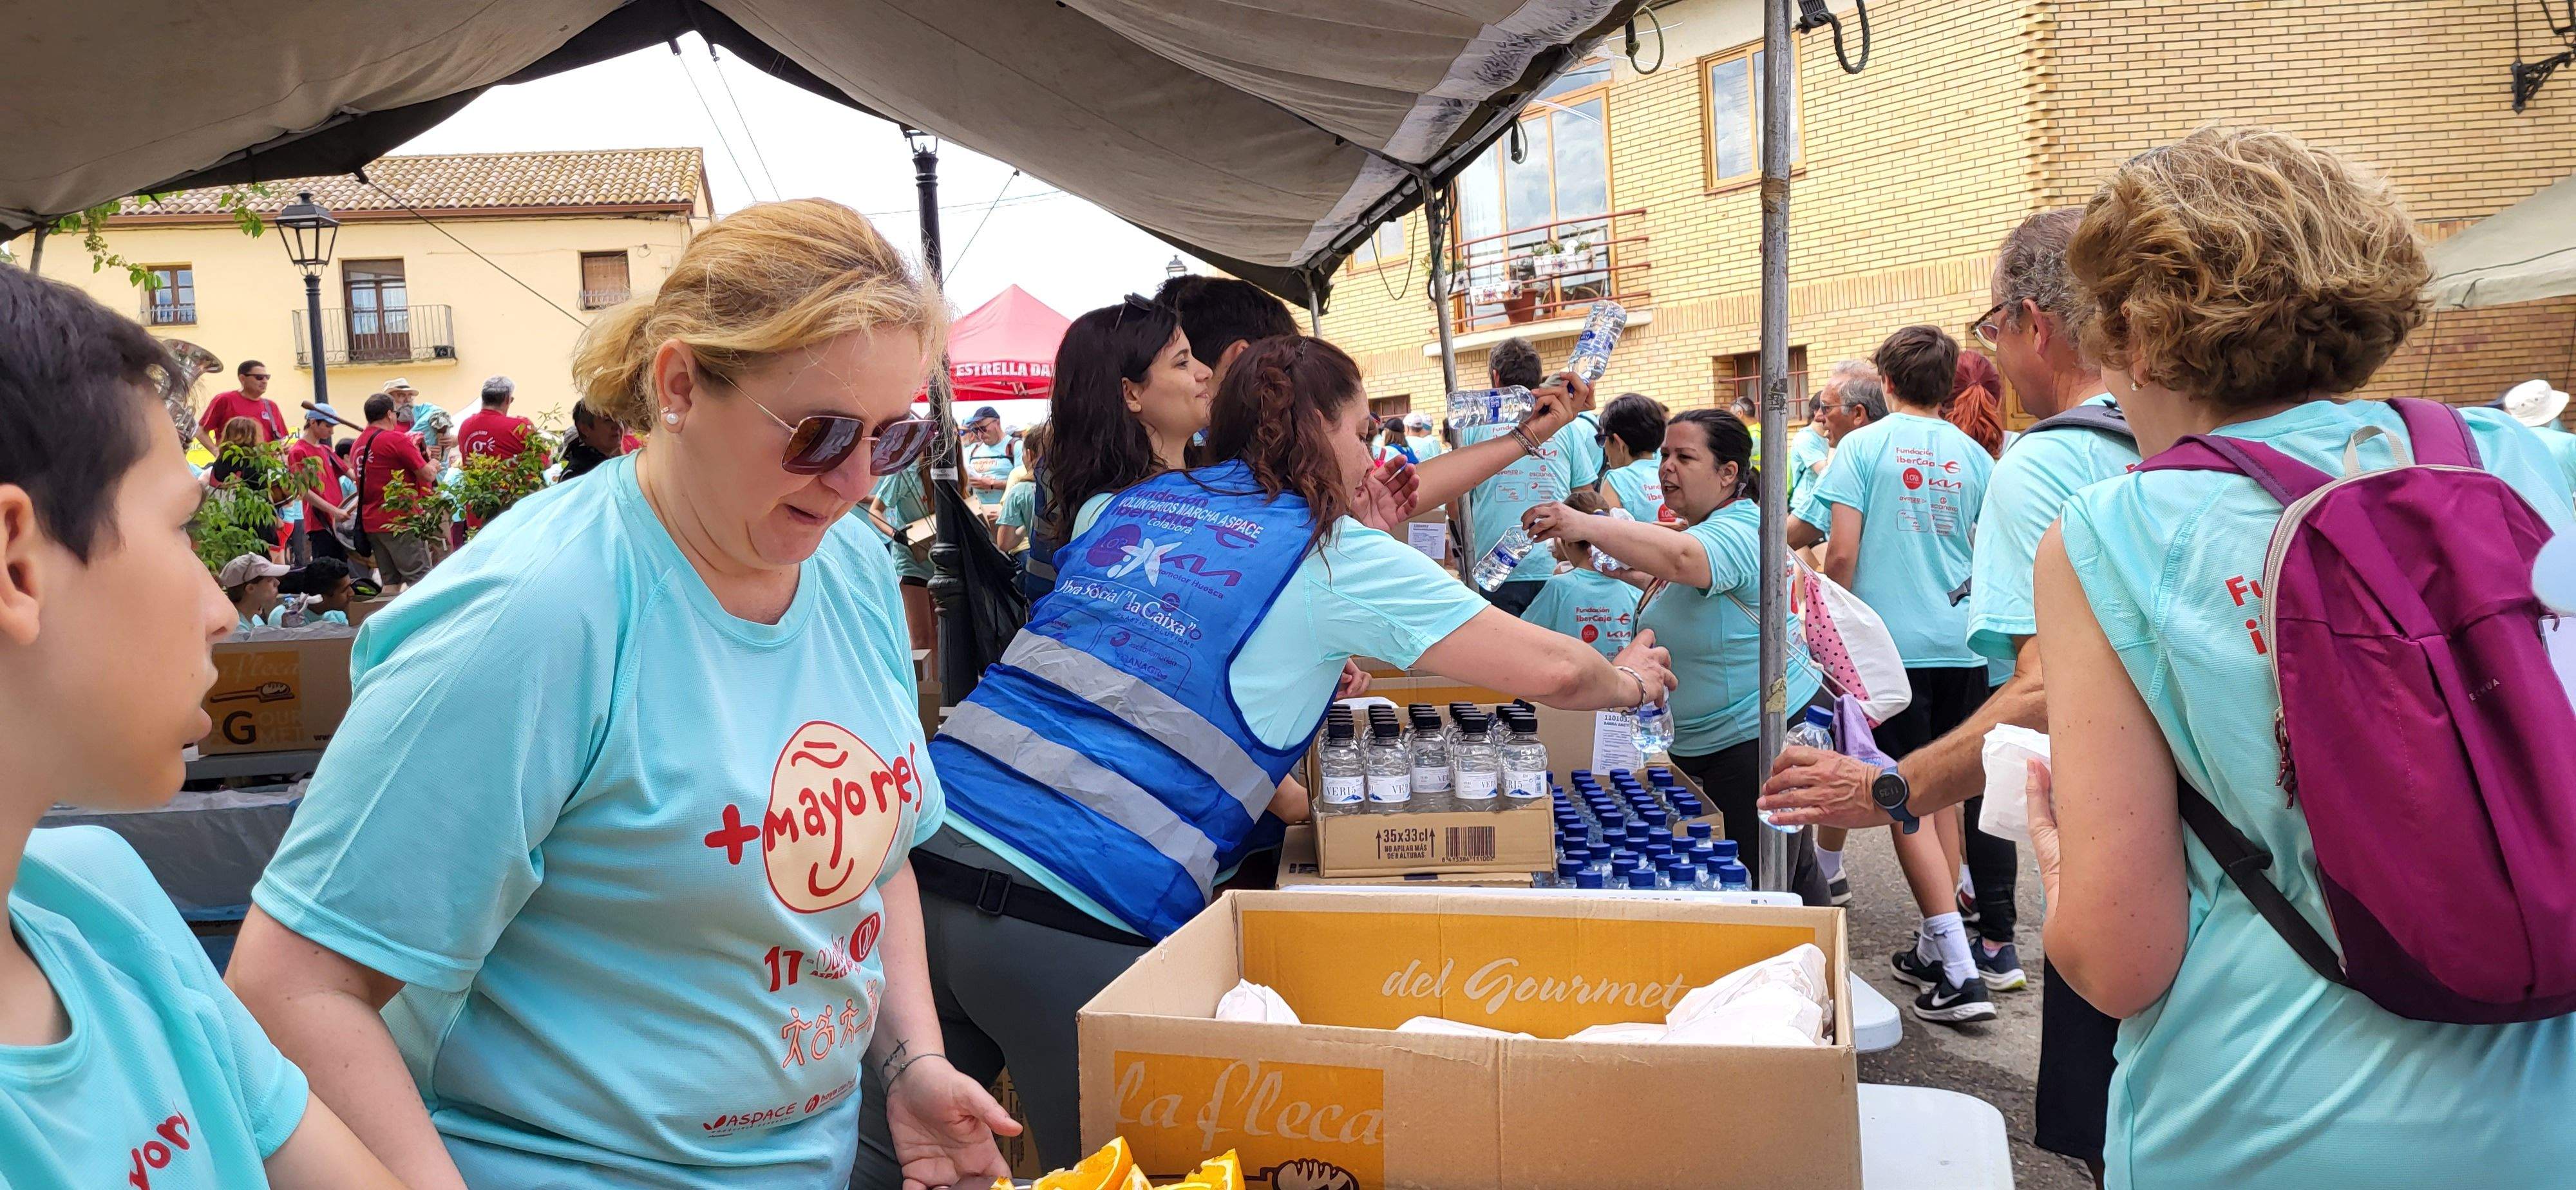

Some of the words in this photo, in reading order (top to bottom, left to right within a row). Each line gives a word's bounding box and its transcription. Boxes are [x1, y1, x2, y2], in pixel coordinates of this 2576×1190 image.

[955, 363, 1028, 377] ESTRELLA
[1030, 363, 1055, 377] DA
[1118, 496, 1179, 514] VOLUNTARIOS
[1177, 502, 1218, 523] MARCHA
[1217, 515, 1264, 540] ASPACE
[1081, 583, 1124, 605] Social
[222, 710, 257, 745] G
[1414, 843, 1428, 851] MÁS
[1381, 957, 1455, 997] del
[1463, 957, 1690, 1015] Gourmet
[726, 1102, 798, 1127] ASPACE
[1115, 1061, 1184, 1129] la
[1197, 1059, 1383, 1151] fleca
